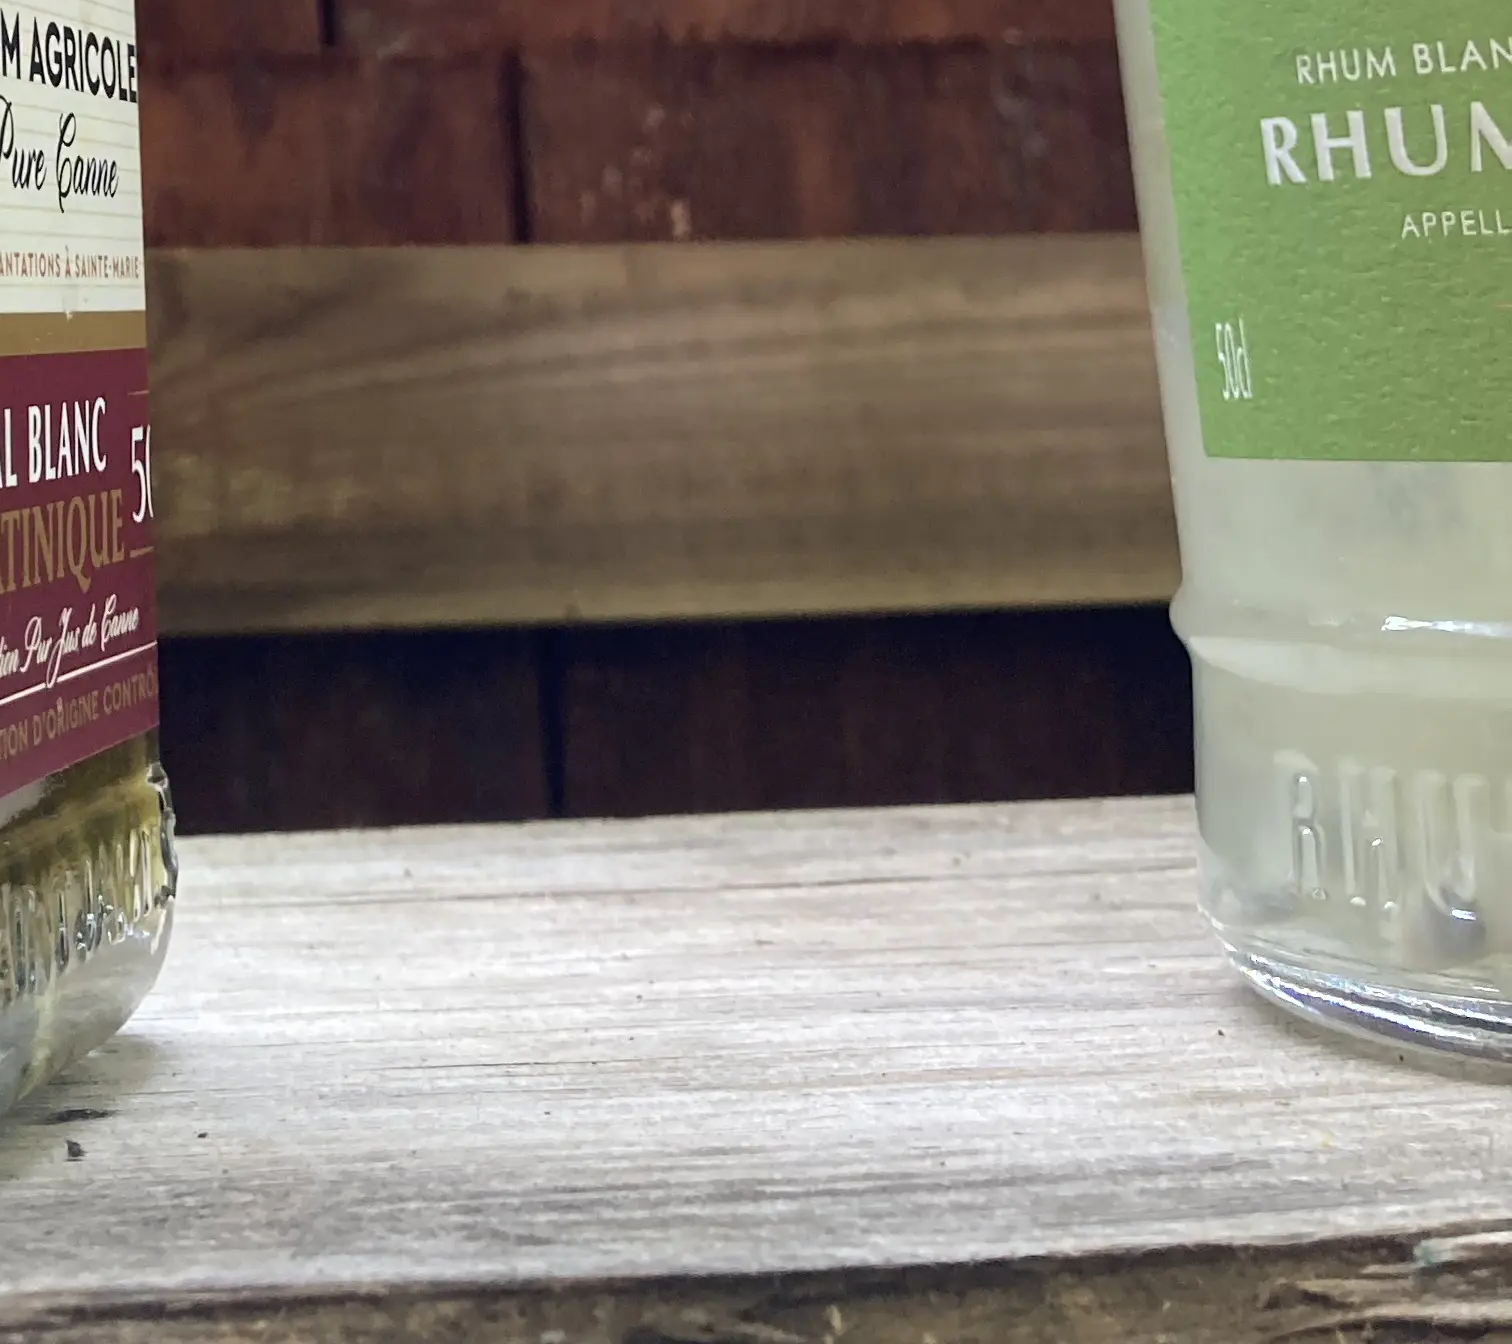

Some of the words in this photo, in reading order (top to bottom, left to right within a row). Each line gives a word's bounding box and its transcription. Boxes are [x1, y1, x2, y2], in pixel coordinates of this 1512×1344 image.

[30, 16, 138, 103] AGRICOLE
[1295, 46, 1397, 85] RHUM
[1412, 37, 1512, 75] BLAN
[55, 112, 119, 214] Canne
[1401, 209, 1512, 239] APPELL
[65, 244, 72, 278] À
[76, 253, 139, 279] SAINTE-MARIE
[28, 396, 107, 483] BLANC
[20, 616, 53, 673] Pur
[46, 607, 80, 688] Jus
[81, 603, 97, 648] de
[100, 594, 139, 652] Canne
[103, 664, 159, 716] CONTRÔ
